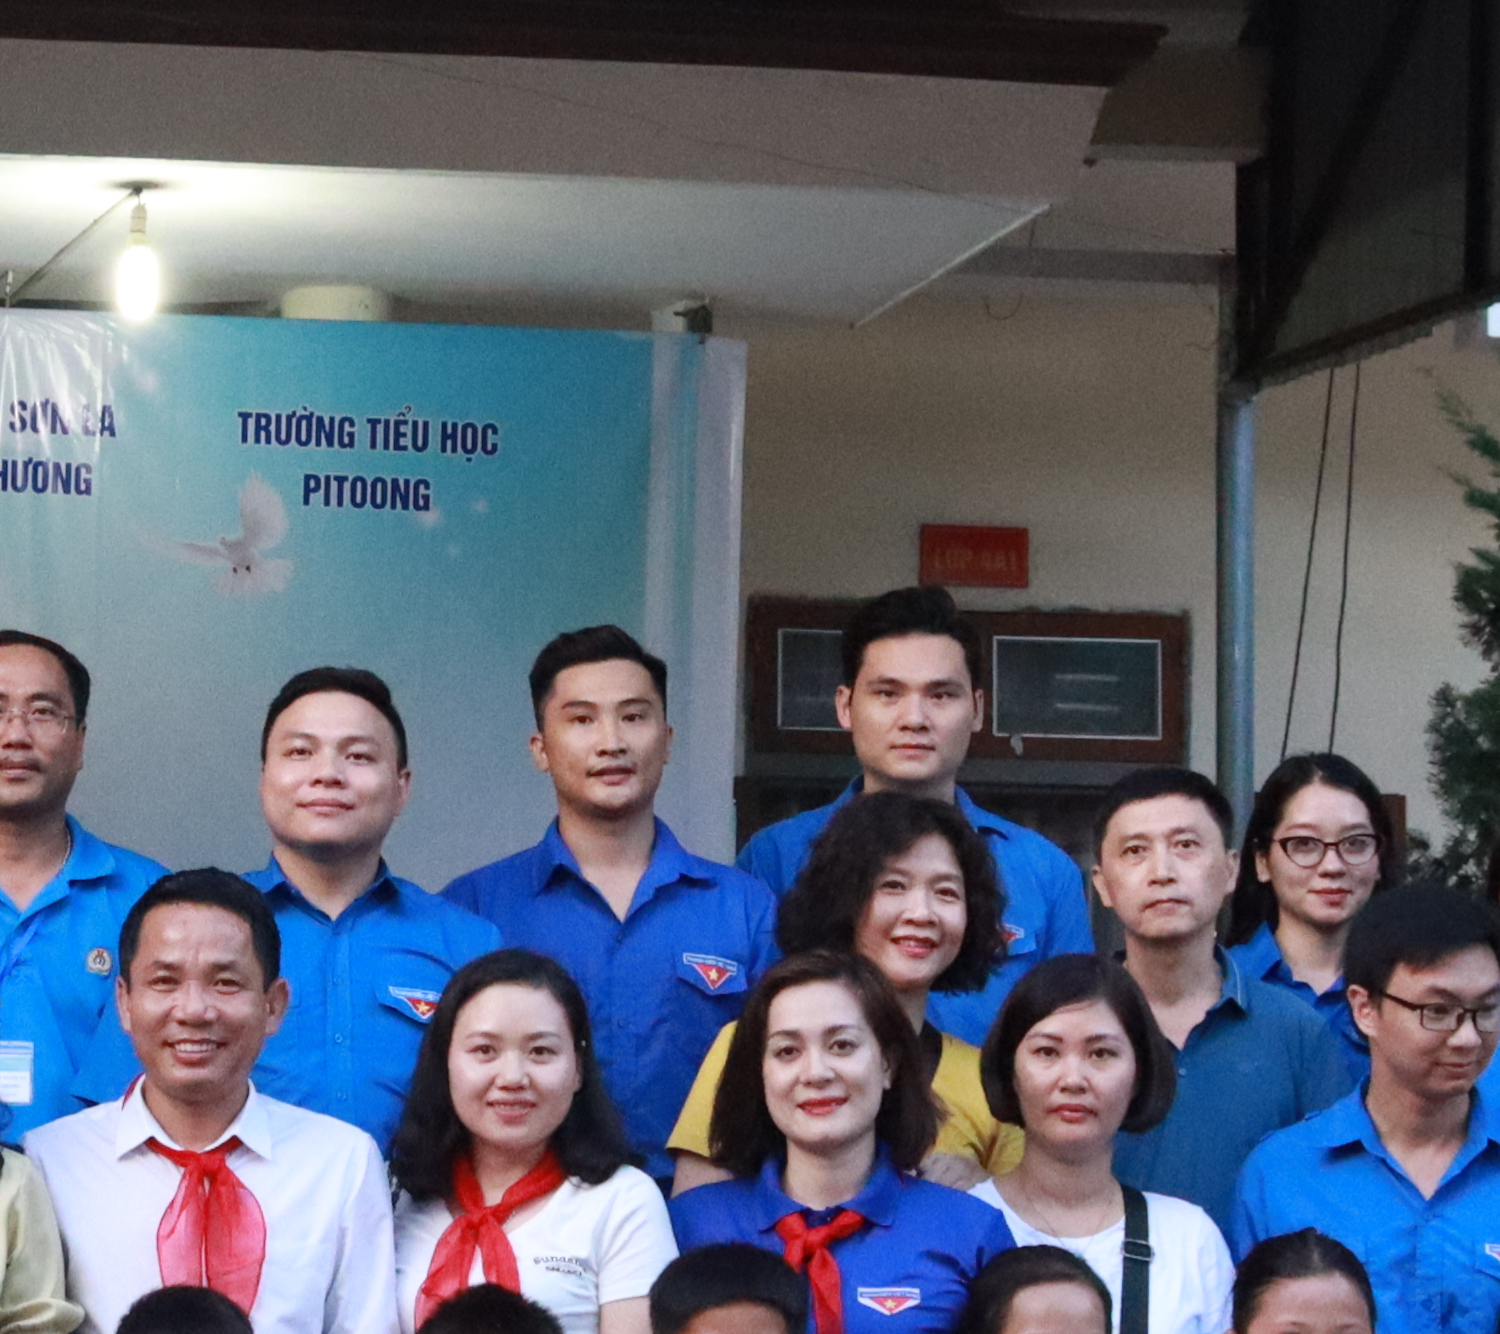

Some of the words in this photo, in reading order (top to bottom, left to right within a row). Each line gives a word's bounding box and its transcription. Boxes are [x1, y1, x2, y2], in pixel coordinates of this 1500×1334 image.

[8, 393, 74, 439] SƠN
[80, 401, 119, 441] LA
[235, 403, 357, 454] TRƯỜNG
[363, 401, 434, 457] TIỂU
[440, 419, 501, 464] HỌC
[300, 469, 433, 514] PITOONG
